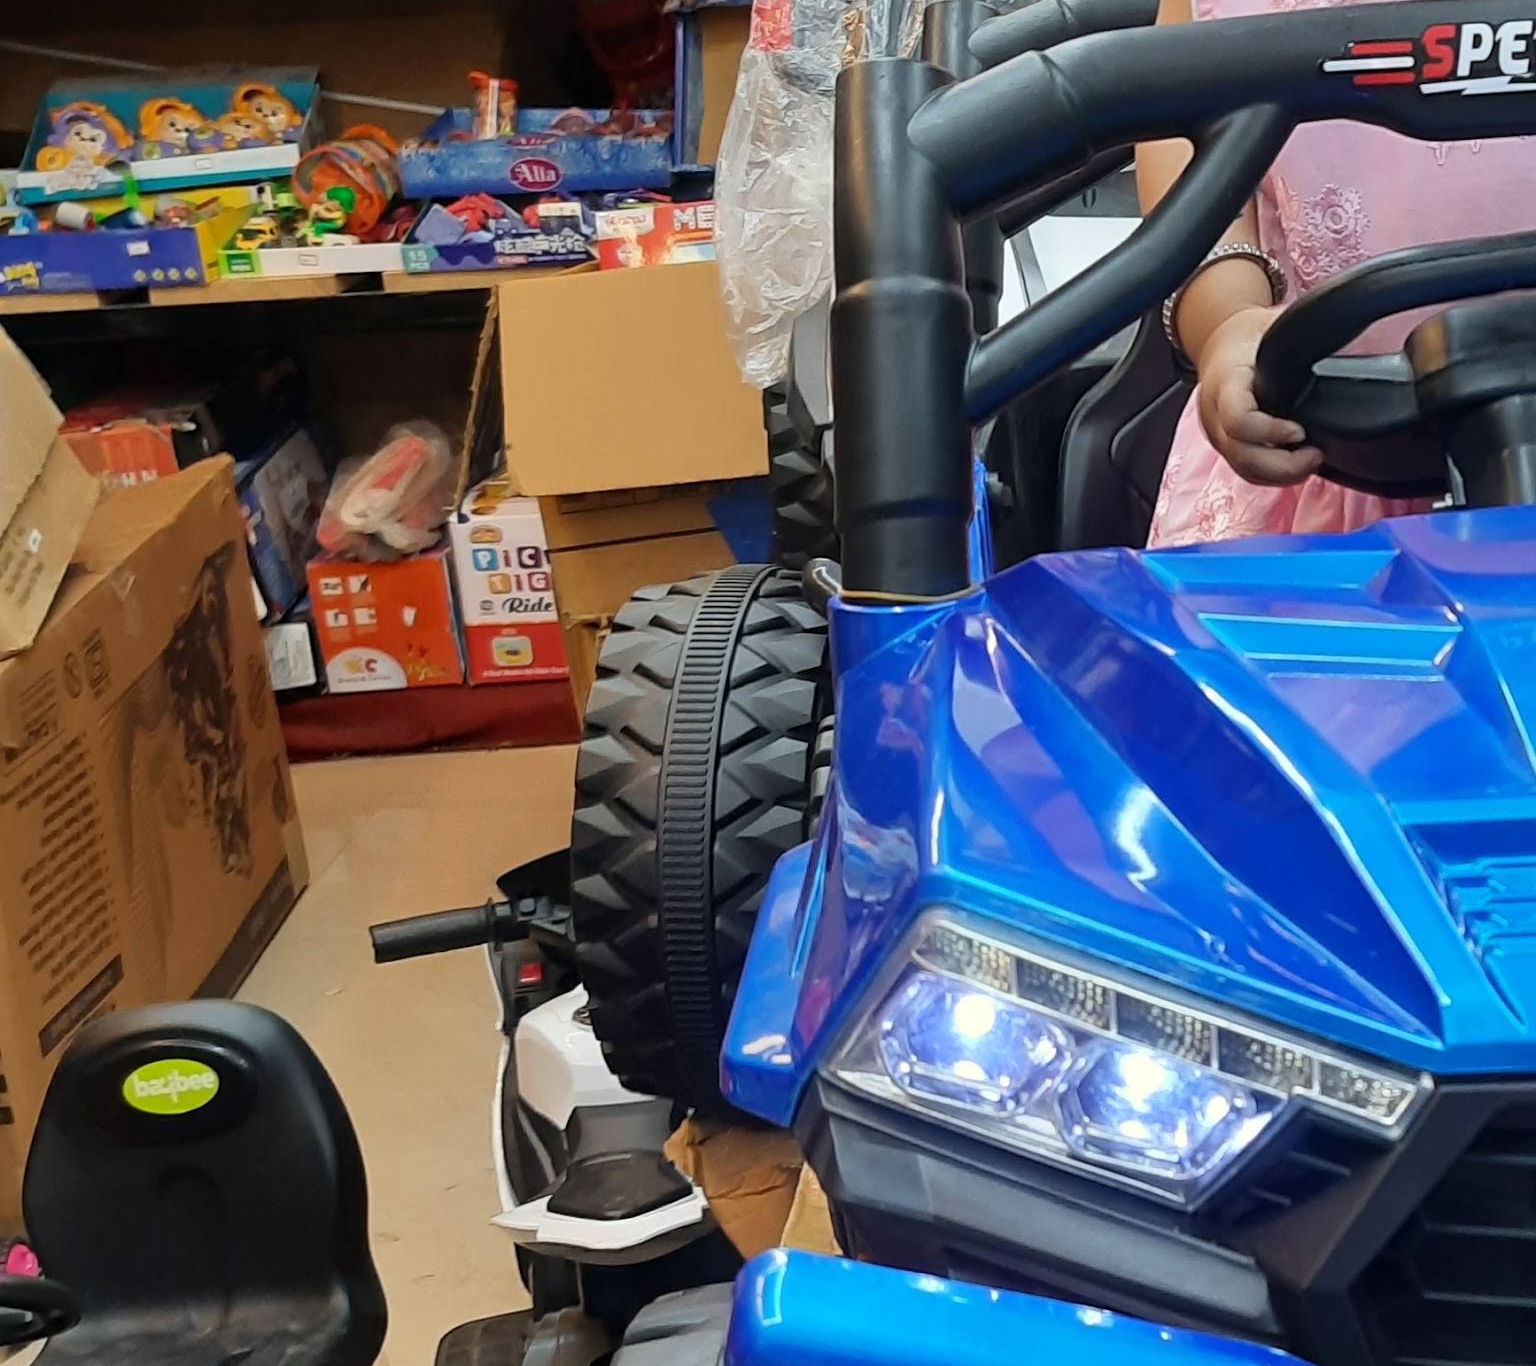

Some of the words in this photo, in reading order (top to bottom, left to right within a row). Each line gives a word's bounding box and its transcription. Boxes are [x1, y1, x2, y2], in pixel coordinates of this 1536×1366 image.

[515, 164, 558, 186] Alla
[502, 596, 555, 614] Ride
[132, 1069, 216, 1104] baybee
